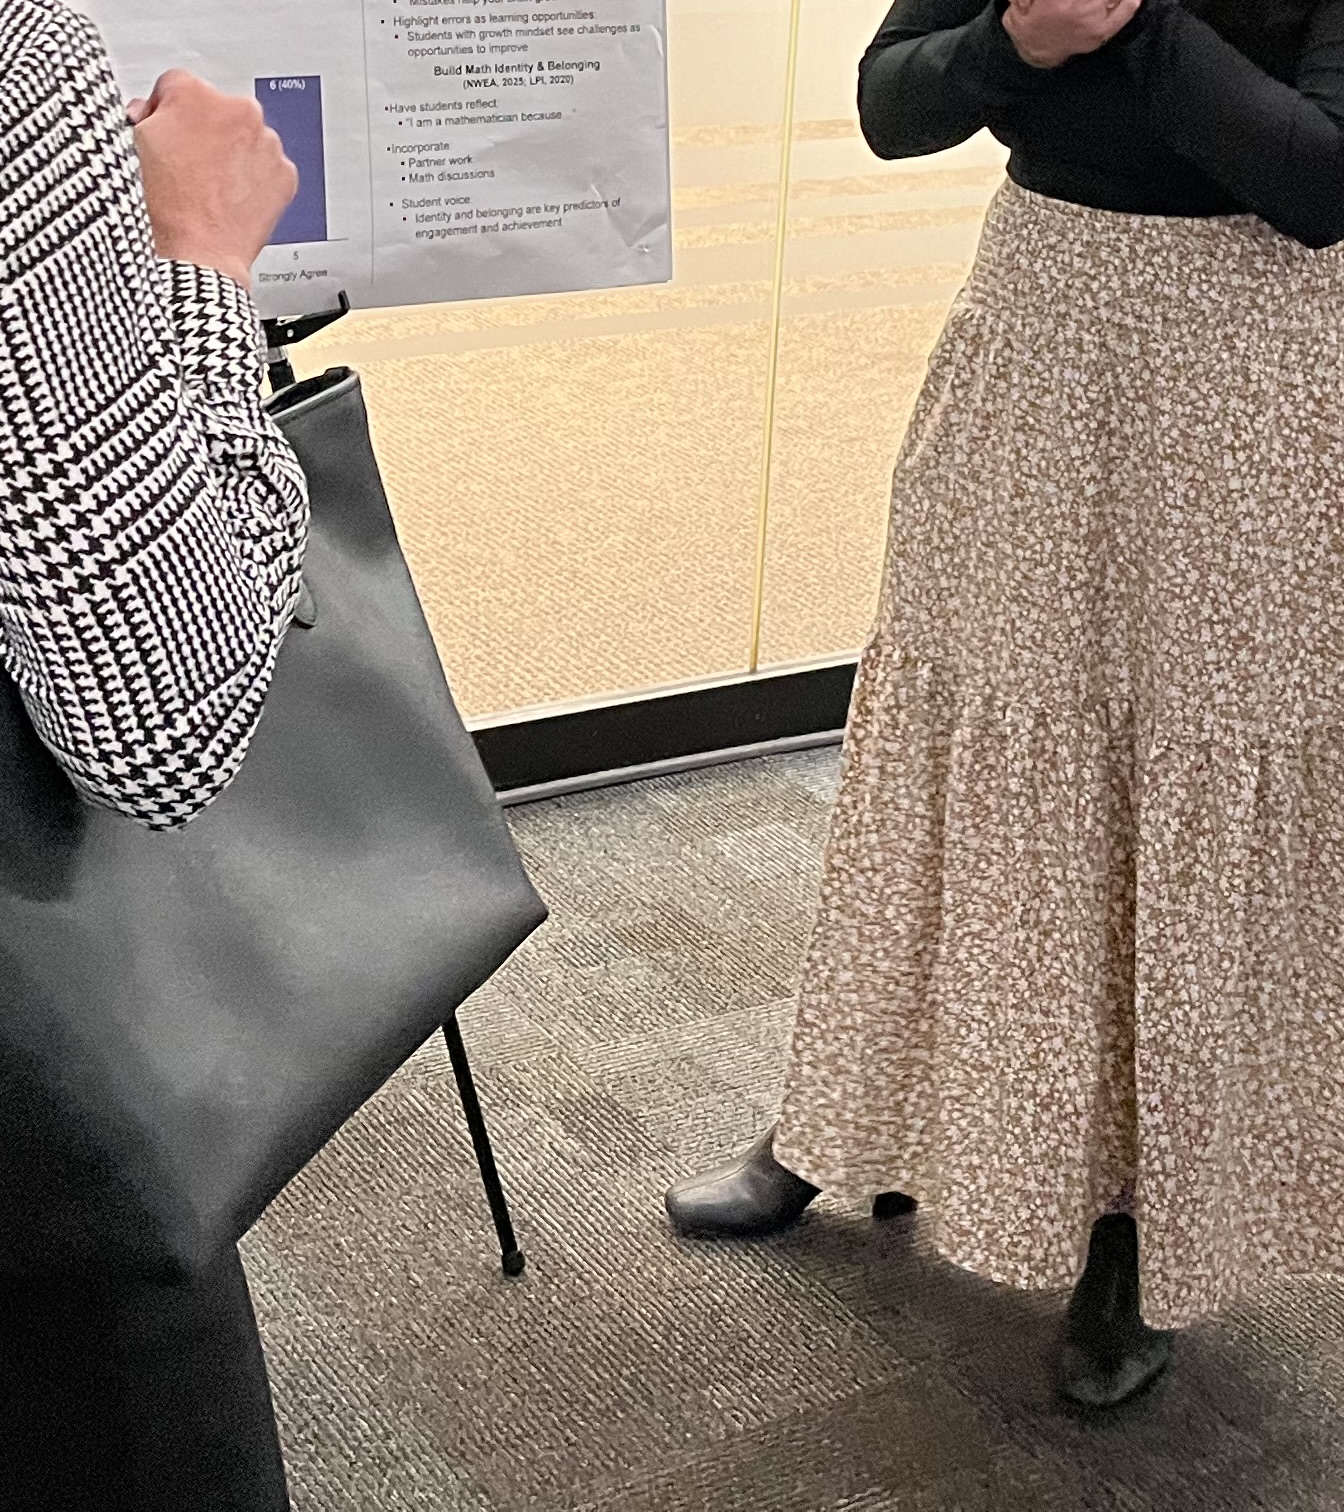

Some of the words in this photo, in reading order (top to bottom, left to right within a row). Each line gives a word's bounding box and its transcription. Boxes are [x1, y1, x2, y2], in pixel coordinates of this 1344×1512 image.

[433, 63, 463, 78] Build
[465, 62, 492, 76] Math
[494, 61, 534, 75] Identity
[536, 60, 545, 73] &
[547, 58, 601, 73] Belonging
[269, 79, 277, 91] 6
[278, 78, 306, 93] (40%)
[408, 156, 447, 169] Partner
[448, 153, 474, 167] work
[408, 171, 435, 185] Math
[437, 168, 496, 183] discussions
[292, 250, 300, 262] 5
